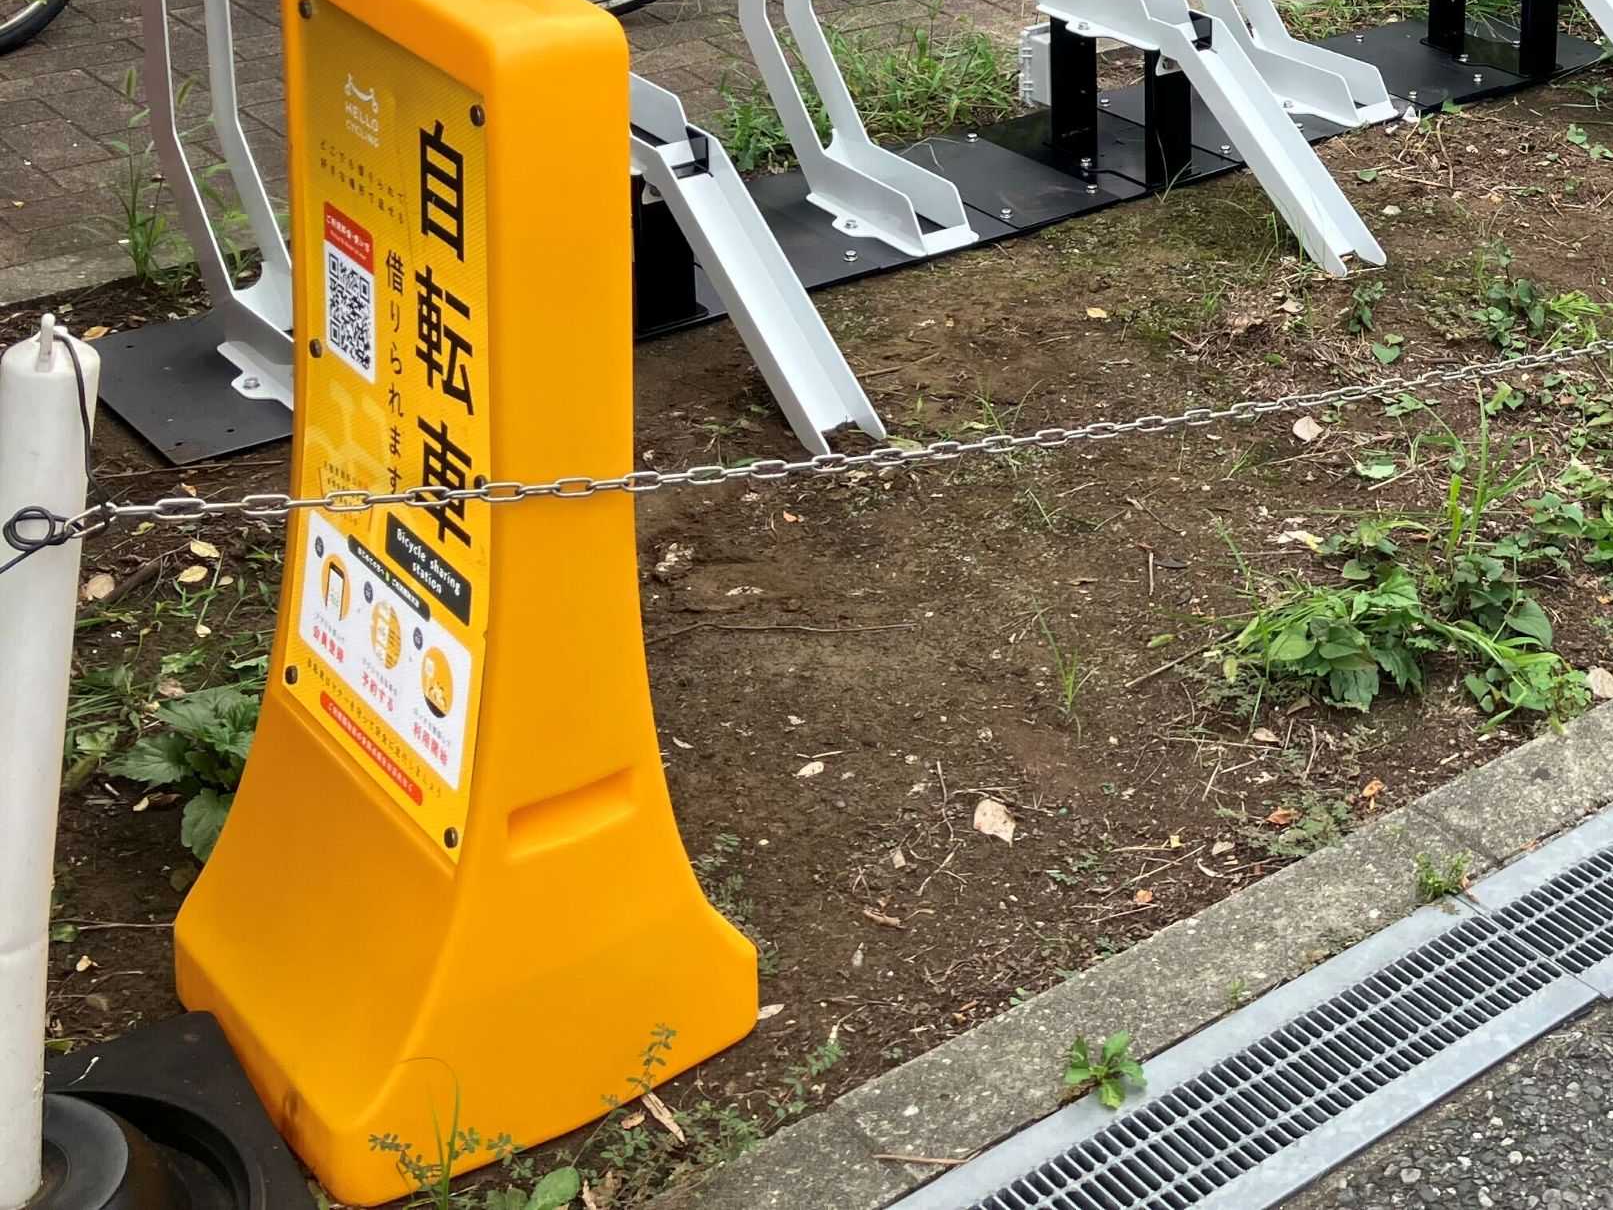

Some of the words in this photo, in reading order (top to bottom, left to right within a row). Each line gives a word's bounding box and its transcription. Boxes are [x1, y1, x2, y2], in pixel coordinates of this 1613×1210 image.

[345, 102, 379, 132] HELLO
[414, 119, 475, 549] 自転車
[385, 249, 405, 495] 借りられます
[396, 528, 427, 563] Bicycle
[430, 554, 462, 597] sharing
[412, 562, 443, 595] station
